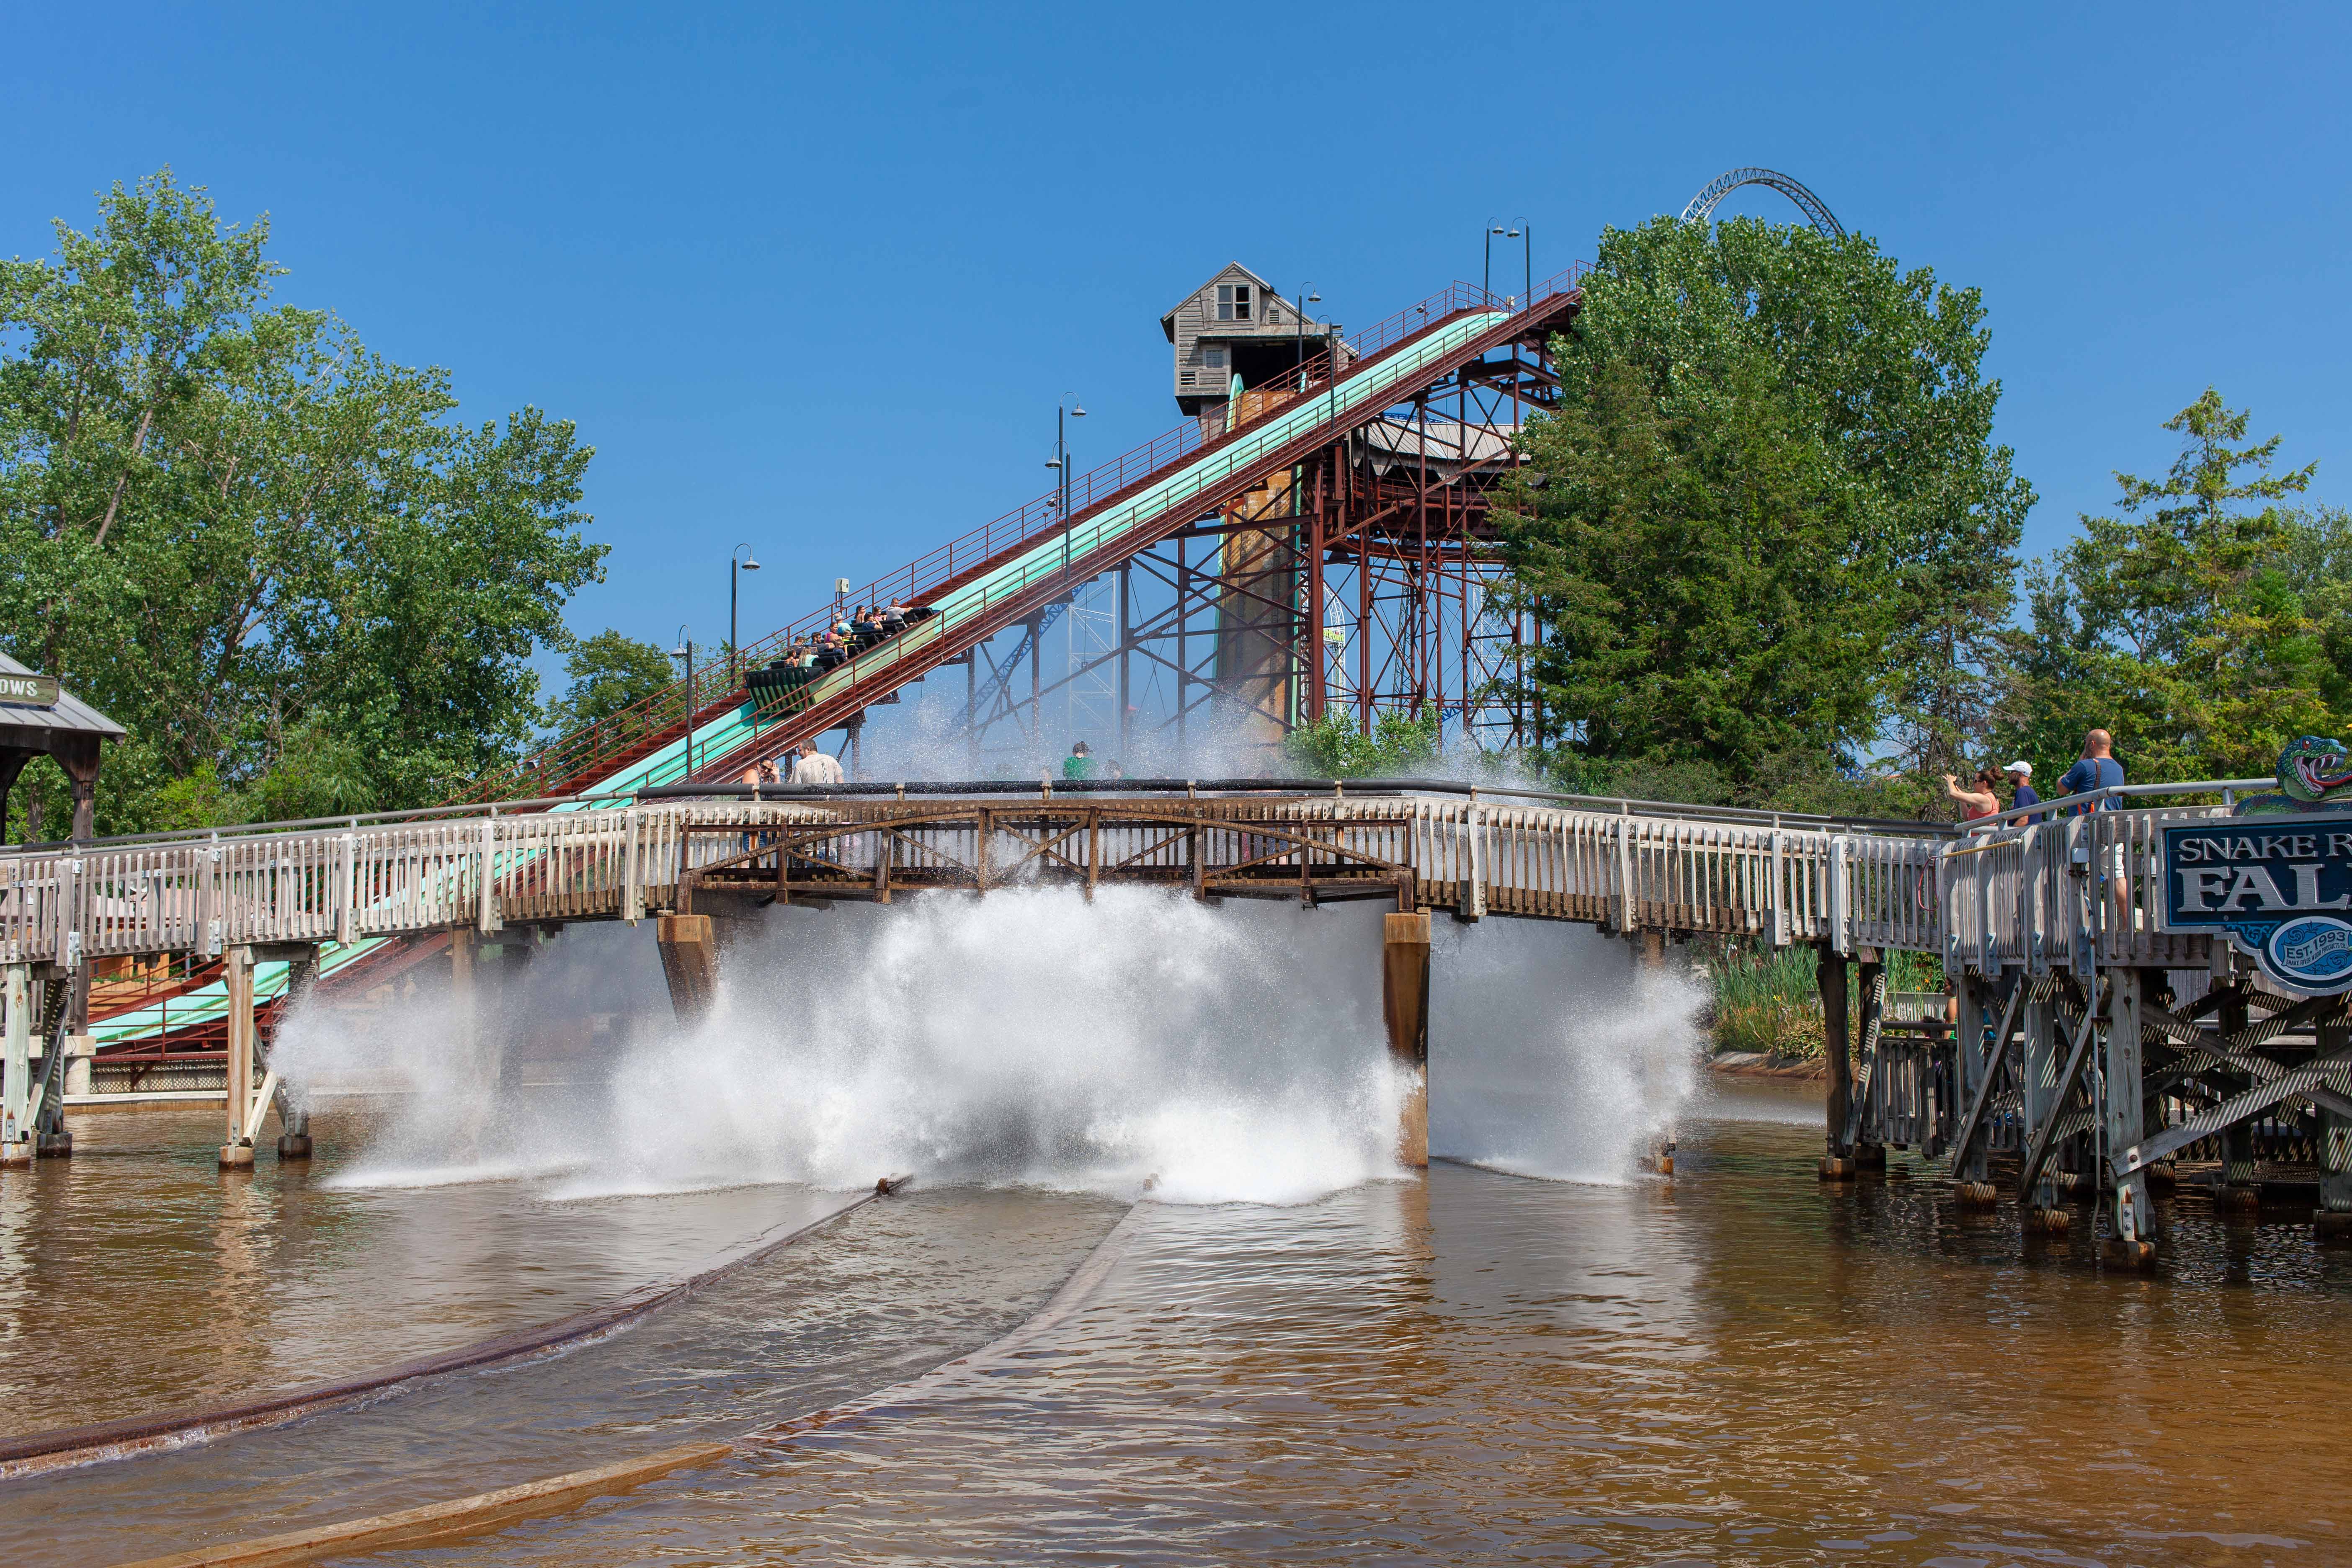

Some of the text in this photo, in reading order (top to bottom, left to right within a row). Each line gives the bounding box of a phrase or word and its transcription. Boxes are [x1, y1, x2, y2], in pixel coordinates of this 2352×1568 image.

[2179, 834, 2318, 861] SNAKE
[2176, 864, 2352, 912] FAL
[2287, 932, 2345, 959] EST. 1993
[2311, 950, 2321, 961] WOOD
[2322, 943, 2339, 954] PRODUCTS
